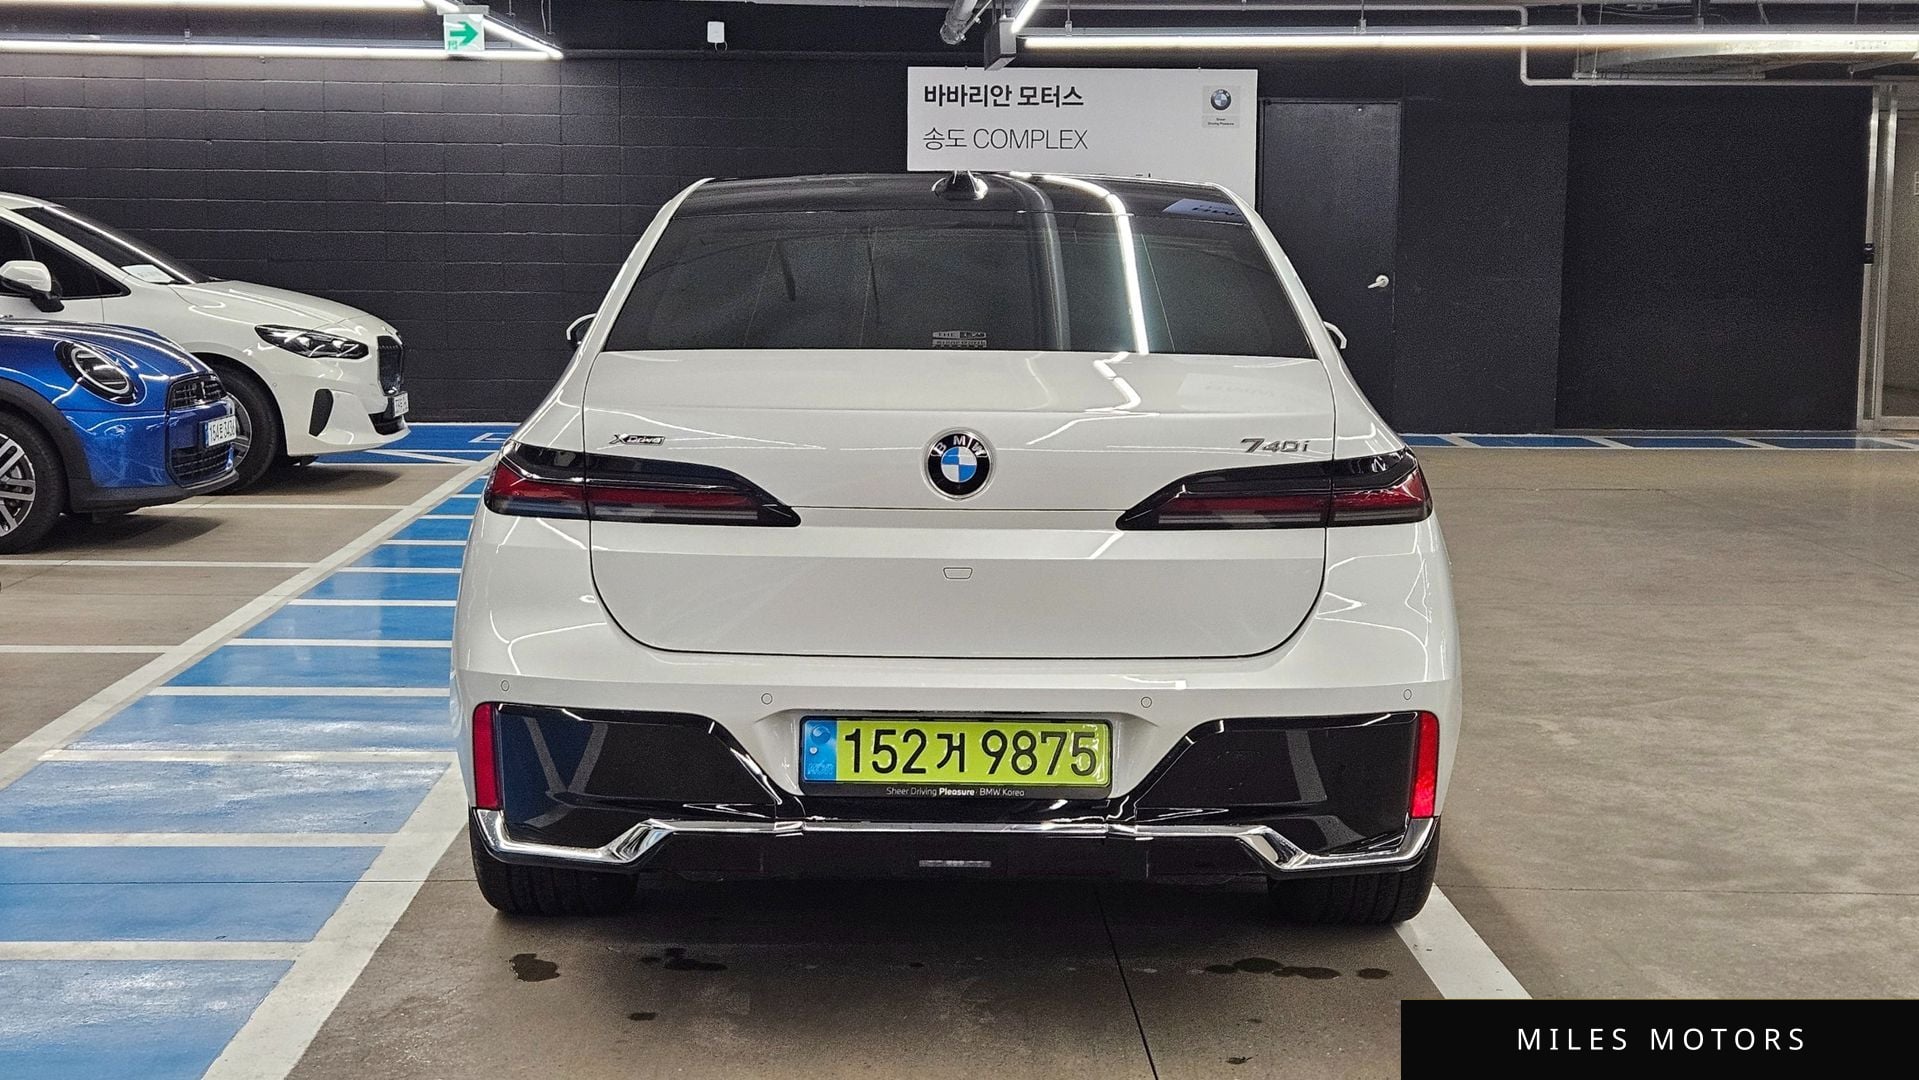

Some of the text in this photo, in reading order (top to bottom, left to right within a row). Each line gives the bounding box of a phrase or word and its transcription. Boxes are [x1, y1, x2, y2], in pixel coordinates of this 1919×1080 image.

[924, 84, 1084, 108] 바바리안 모터스
[923, 127, 1088, 150] 송도 COMPLEX
[933, 435, 986, 455] BMW
[1240, 438, 1310, 453] 740i
[844, 728, 1099, 776] 152거 9875
[886, 786, 1025, 797] Sheer Driving Pleasure BMW Korea
